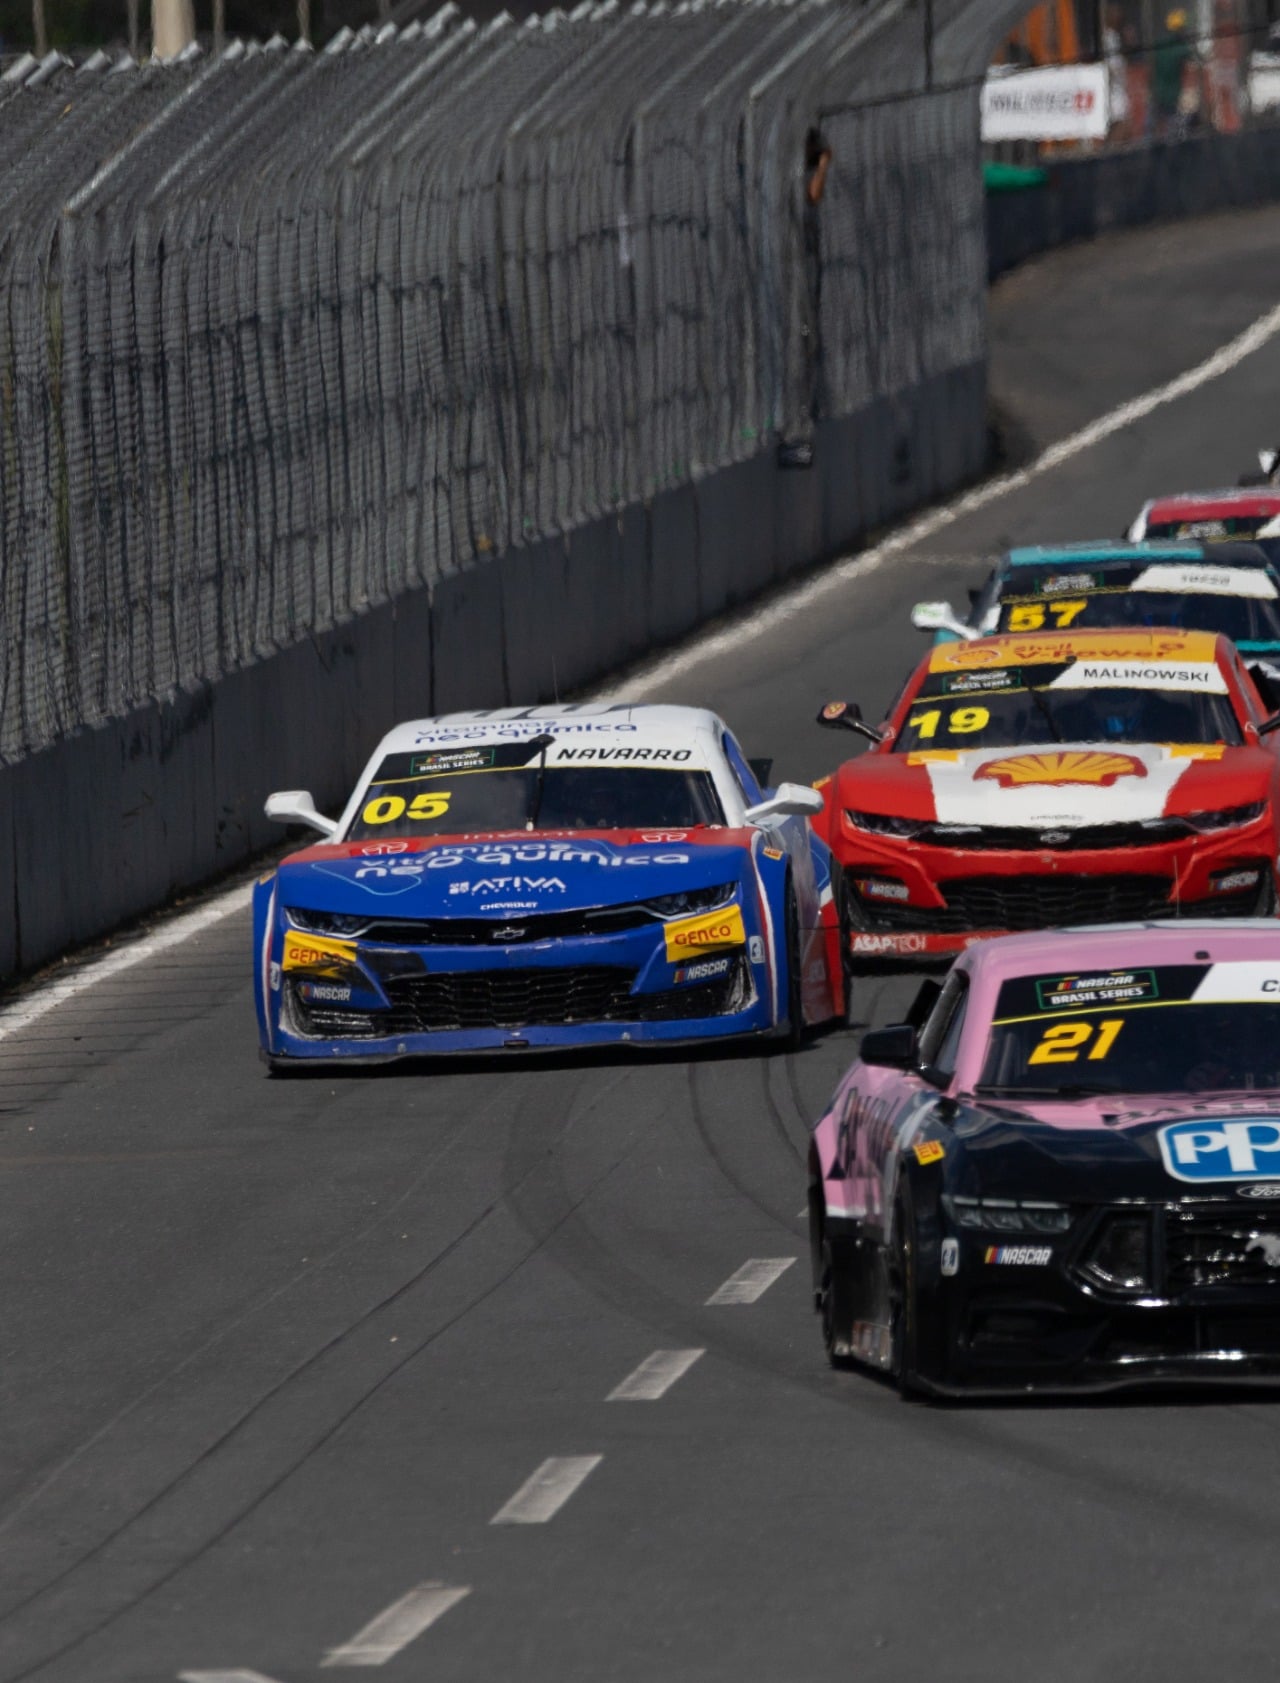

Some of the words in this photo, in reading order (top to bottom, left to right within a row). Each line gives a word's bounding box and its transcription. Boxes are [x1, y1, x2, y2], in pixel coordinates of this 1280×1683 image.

[1008, 600, 1087, 632] 57
[1083, 667, 1209, 682] MALINOWSKI
[908, 706, 990, 738] 19
[414, 731, 487, 745] neo
[438, 750, 481, 764] NASCAR
[556, 748, 693, 762] NAVARRO
[418, 761, 450, 773] BRASIL
[453, 758, 485, 769] SERIES
[361, 791, 452, 825] 05
[355, 855, 464, 879] neo
[471, 876, 566, 893] ATIVA
[480, 902, 539, 911] CHEVROLET
[674, 925, 732, 946] GENCO
[687, 959, 728, 980] NASCAR
[1075, 974, 1135, 990] NASCAR
[312, 986, 351, 1001] NASCAR
[1050, 992, 1098, 1005] BRASIL
[1101, 987, 1144, 999] SERIES
[1027, 1019, 1125, 1065] 21
[999, 1246, 1053, 1266] NASCAR
